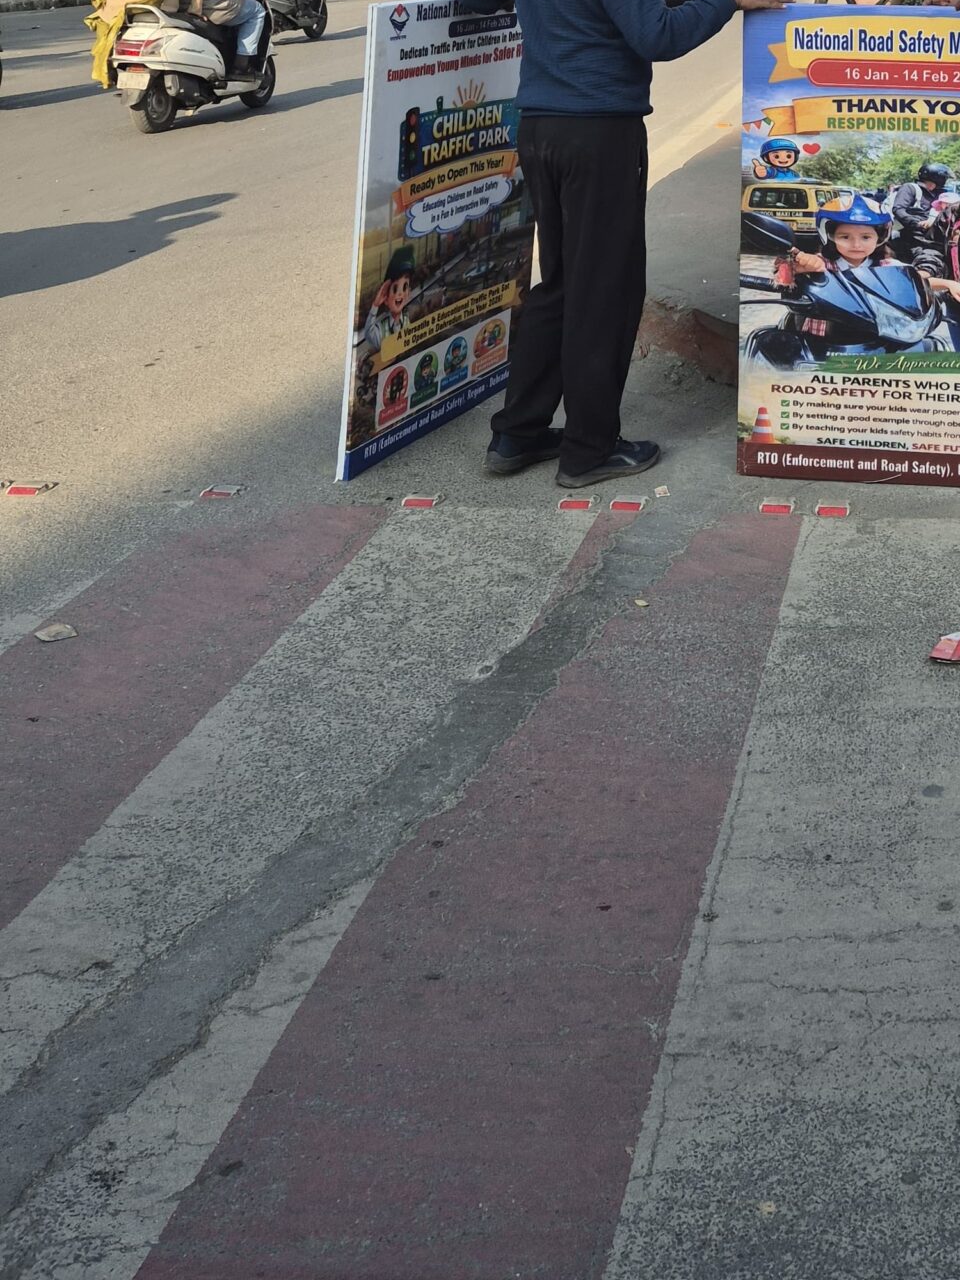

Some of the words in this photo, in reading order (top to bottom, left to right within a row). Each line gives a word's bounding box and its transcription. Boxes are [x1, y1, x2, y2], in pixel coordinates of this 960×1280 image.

[417, 1, 451, 21] National
[400, 47, 428, 61] Dedicate
[431, 42, 450, 54] Traffic
[452, 40, 466, 51] Park
[477, 34, 500, 47] Children
[502, 33, 507, 42] in
[793, 27, 854, 51] National
[858, 29, 894, 53] Road
[899, 30, 944, 59] Safety
[387, 62, 435, 82] Empowering
[437, 58, 459, 73] Young
[460, 54, 481, 69] Minds
[483, 52, 492, 64] for
[493, 46, 515, 62] Safer
[845, 68, 860, 80] 16
[864, 69, 888, 81] Jan
[903, 70, 919, 82] 14
[923, 71, 948, 83] Feb
[832, 99, 921, 114] THANK
[432, 104, 503, 140] CHILDREN
[827, 117, 928, 132] RESPONSIBLE
[422, 132, 475, 166] TRAFFIC
[478, 125, 511, 149] PARK
[410, 177, 435, 196] Ready
[437, 173, 445, 184] to
[447, 165, 468, 180] Open
[470, 161, 484, 172] This
[486, 156, 504, 169] Year!
[854, 358, 880, 371] We
[811, 374, 838, 385] ALL
[842, 376, 910, 389] PARENTS
[914, 380, 950, 391] WHO
[771, 384, 816, 395] ROAD
[820, 386, 878, 398] SAFETY
[883, 389, 914, 400] FOR
[918, 391, 960, 403] THEIR
[793, 400, 804, 408] By
[806, 401, 841, 410] making
[889, 405, 907, 413] kids
[932, 408, 960, 416] proper
[806, 413, 837, 421] setting
[873, 417, 910, 425] example
[912, 418, 945, 427] through
[806, 424, 845, 433] teaching
[890, 429, 915, 437] safety
[917, 430, 942, 438] habits
[817, 437, 846, 445] SAFE
[849, 439, 909, 450] CHILDREN,
[912, 443, 943, 451] SAFE
[757, 452, 778, 465] RTO
[781, 452, 855, 470] (Enforcement
[857, 460, 878, 471] and
[880, 460, 909, 472] Road
